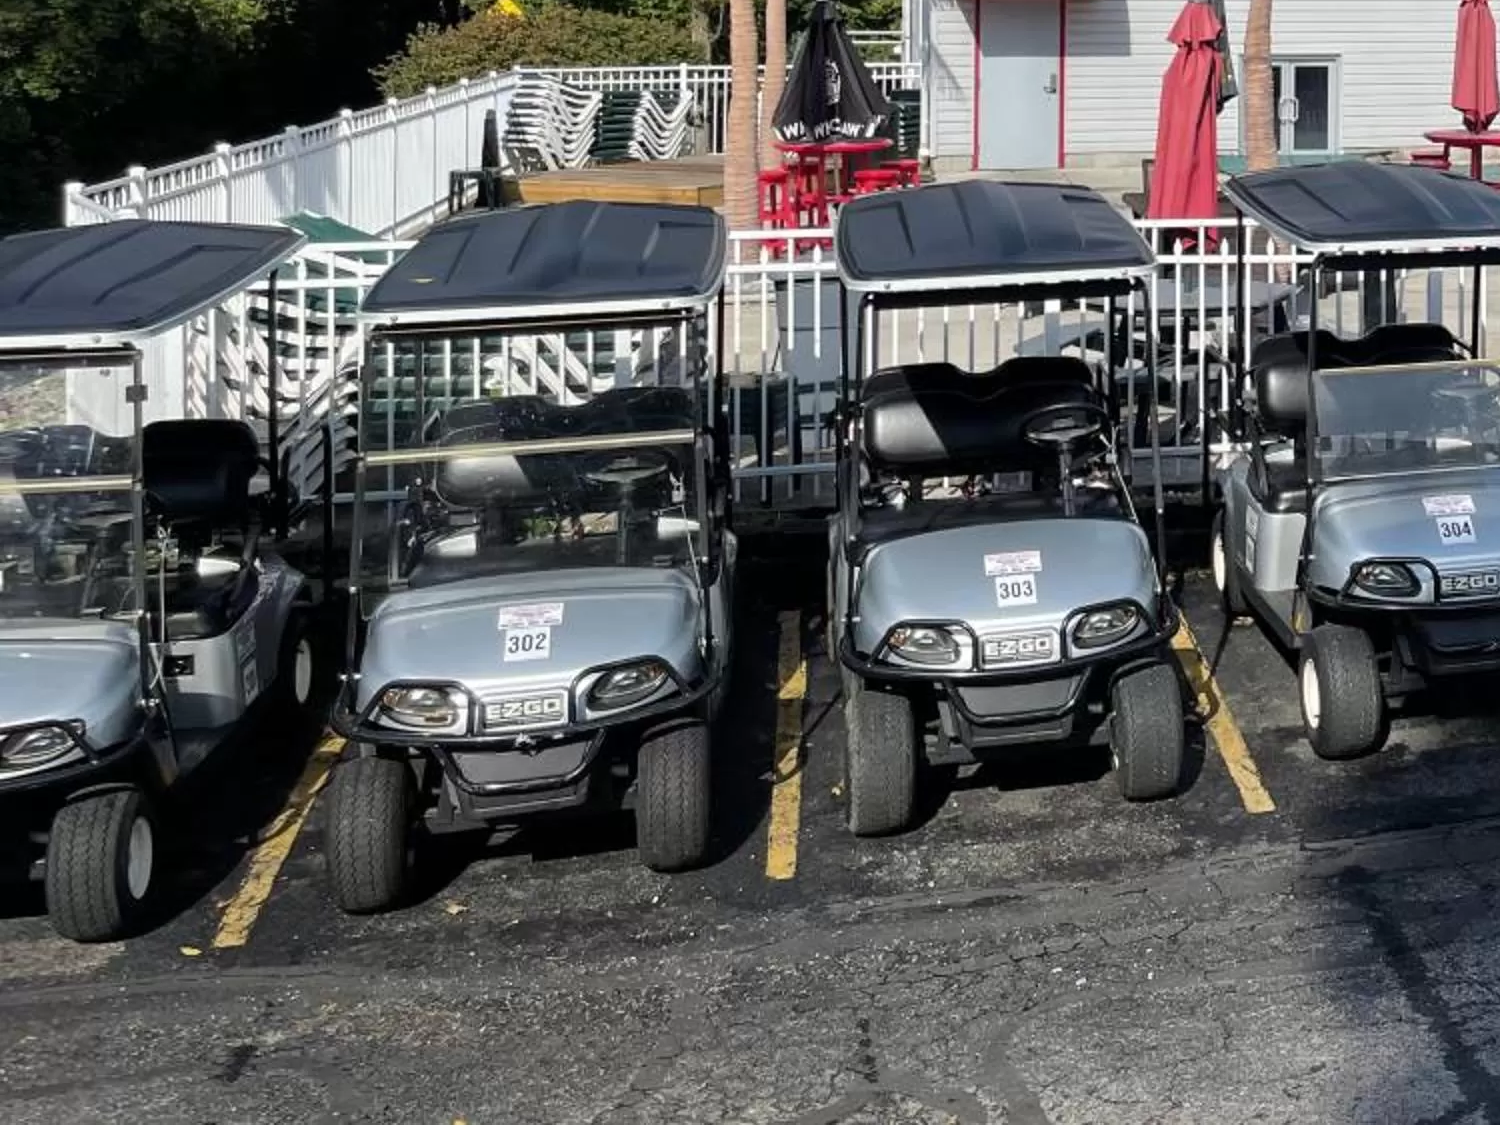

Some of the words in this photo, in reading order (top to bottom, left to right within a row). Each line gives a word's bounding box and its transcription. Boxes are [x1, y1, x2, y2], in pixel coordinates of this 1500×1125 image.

[1440, 520, 1472, 538] 304
[999, 580, 1033, 600] 303
[507, 633, 546, 654] 302
